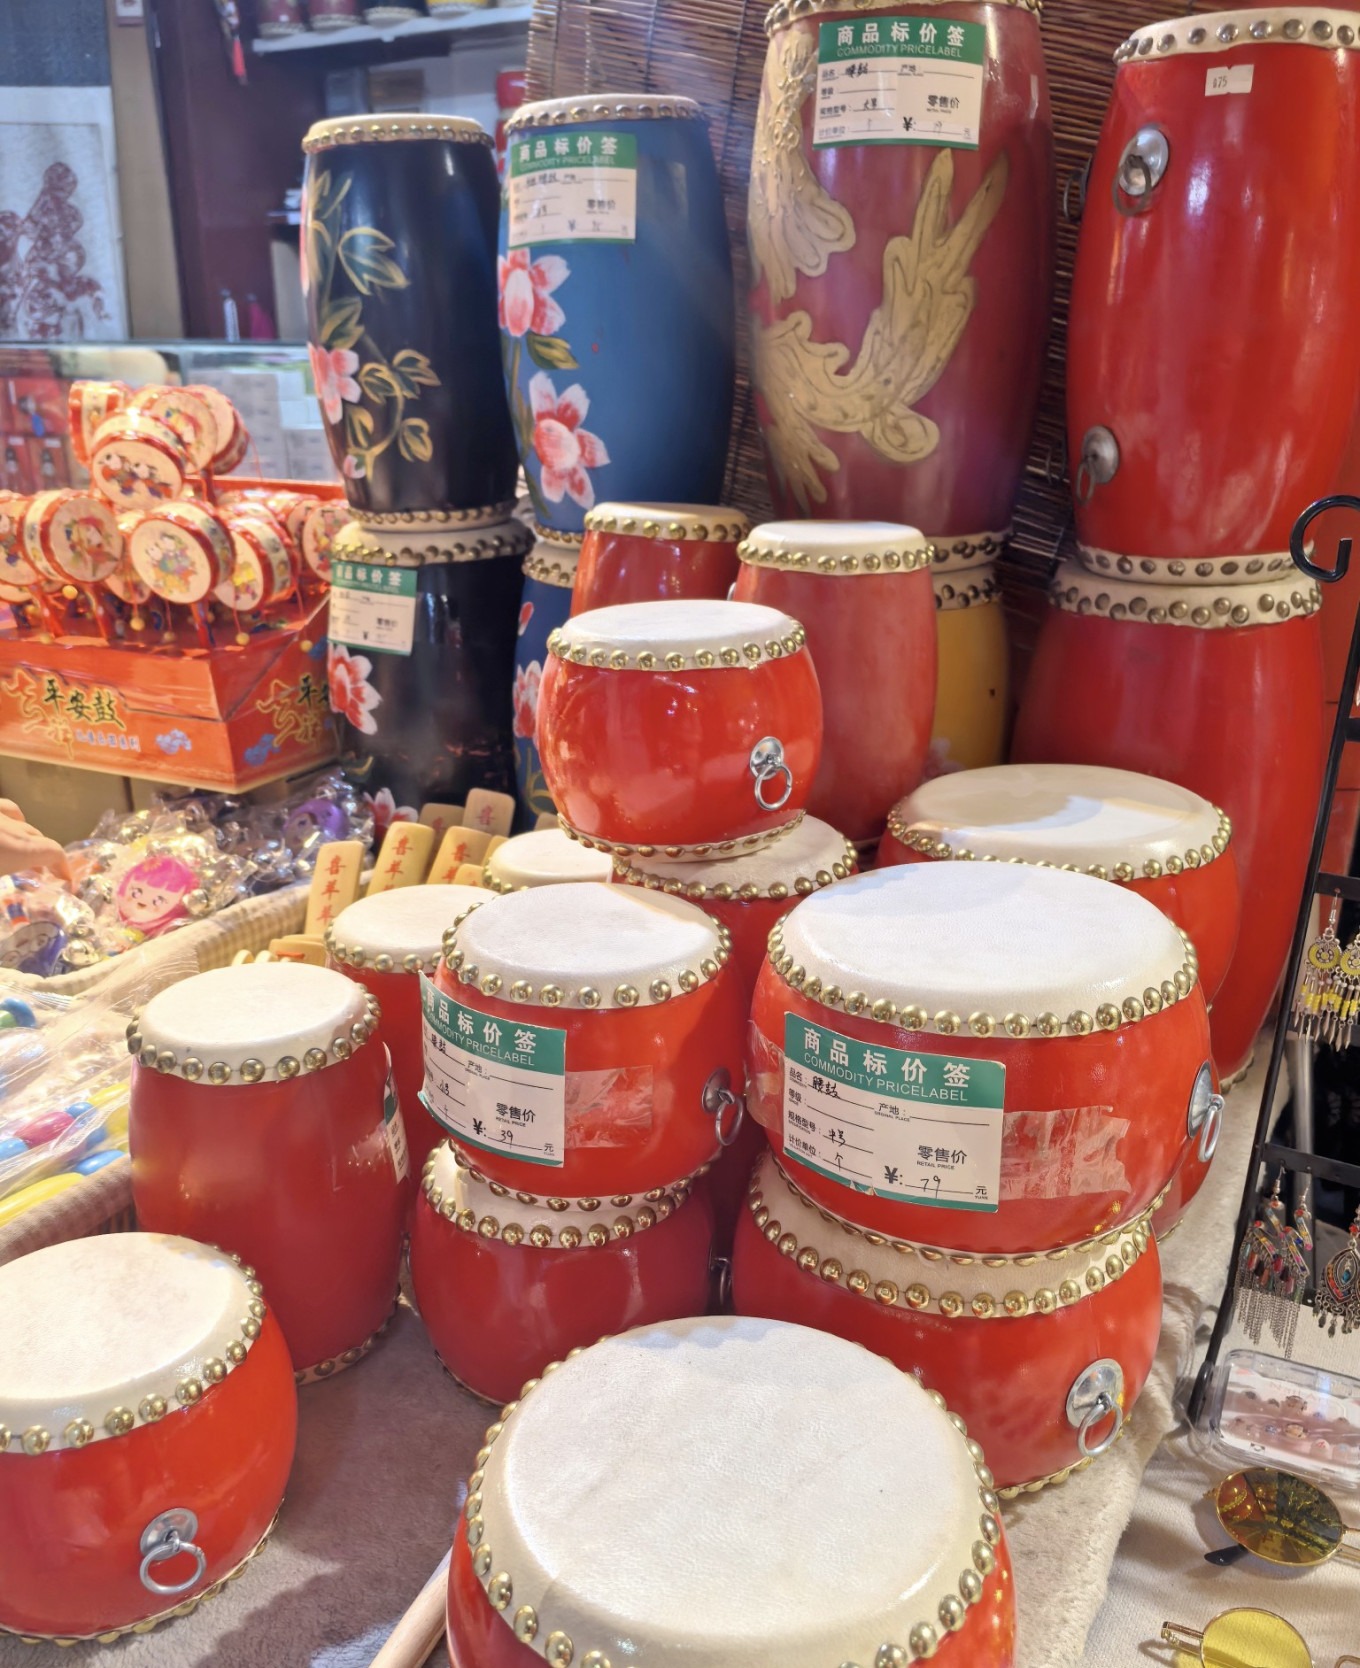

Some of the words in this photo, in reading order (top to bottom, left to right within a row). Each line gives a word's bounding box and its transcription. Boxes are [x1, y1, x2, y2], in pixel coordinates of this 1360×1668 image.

[837, 22, 965, 47] 商品标价签
[837, 44, 897, 57] COMMODITY
[901, 44, 962, 57] PRICELABEL
[44, 677, 126, 730] 平安鼓
[316, 855, 346, 924] 喜羊羊
[466, 1037, 534, 1066] PRICELABEL
[804, 1027, 971, 1089] 商品标价签
[804, 1053, 874, 1088] COMMODITY
[876, 1078, 968, 1102] PRICELABEL
[496, 1103, 535, 1123] 零售价
[500, 1129, 514, 1149] 39
[544, 1142, 554, 1153] 元
[916, 1160, 936, 1168] RETAIL
[917, 1145, 967, 1165] 零售价
[920, 1175, 941, 1199] 79
[975, 1185, 987, 1196] 元
